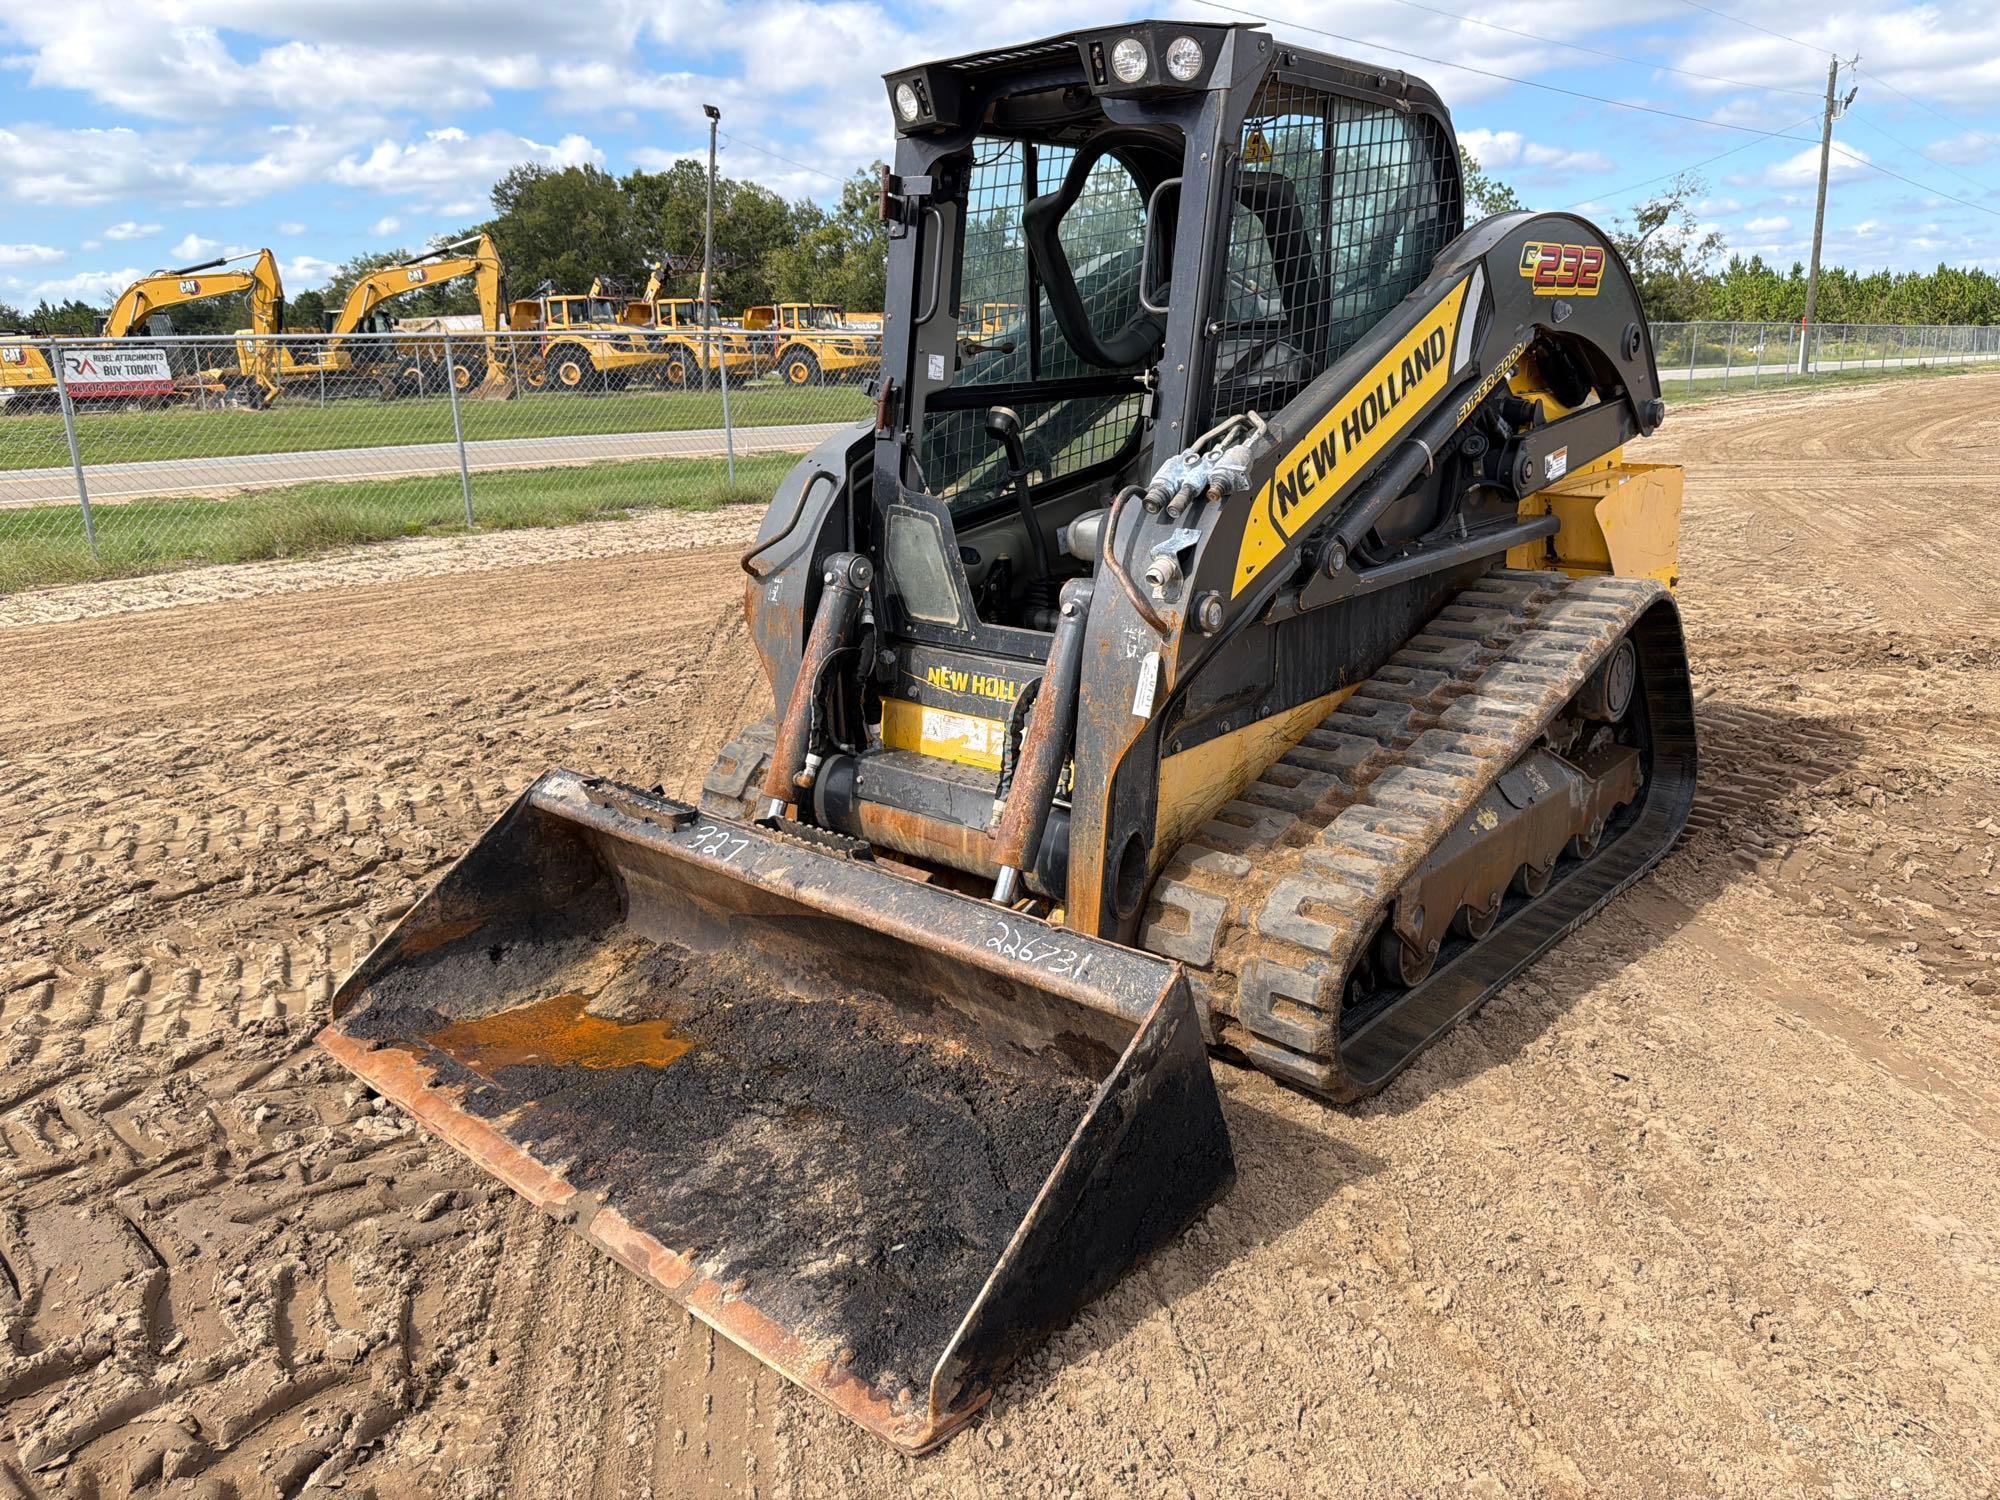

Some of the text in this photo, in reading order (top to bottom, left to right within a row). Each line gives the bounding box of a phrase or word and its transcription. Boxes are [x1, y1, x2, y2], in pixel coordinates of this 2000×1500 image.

[407, 269, 423, 282] CAT
[1519, 242, 1606, 295] C232
[179, 280, 195, 293] CAT
[2, 348, 20, 363] CAT
[93, 352, 165, 362] REBEL ATTACHMENTS
[103, 364, 158, 376] BUY TODAY!
[1456, 373, 1496, 428] SUPER
[1275, 325, 1446, 520] NEW HOLLAND
[927, 666, 969, 692] NEW
[686, 826, 750, 862] 327
[985, 921, 1093, 979] 226731
